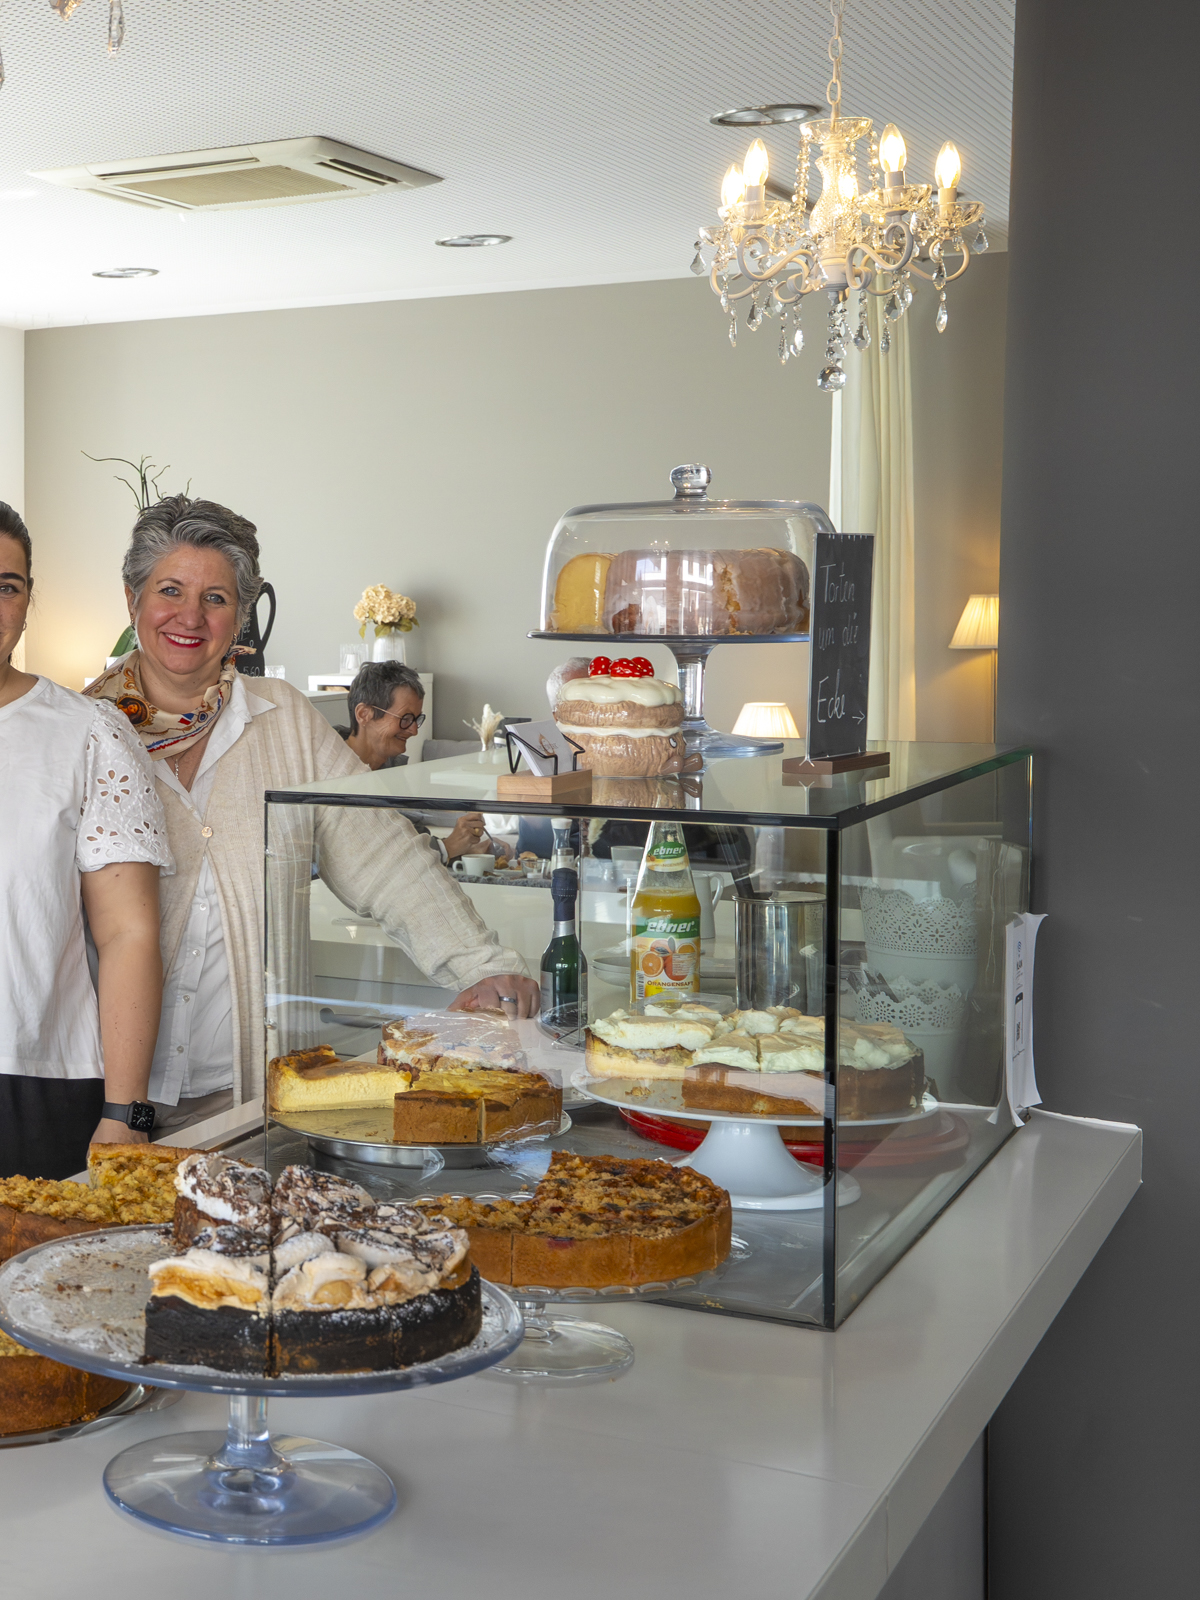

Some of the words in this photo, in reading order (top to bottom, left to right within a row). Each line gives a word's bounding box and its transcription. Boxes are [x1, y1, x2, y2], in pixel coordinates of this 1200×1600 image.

[819, 561, 856, 603] Torten
[818, 626, 835, 651] um
[842, 612, 859, 647] die
[816, 667, 846, 724] Ecke
[652, 844, 684, 857] ebner
[646, 919, 695, 934] ebner
